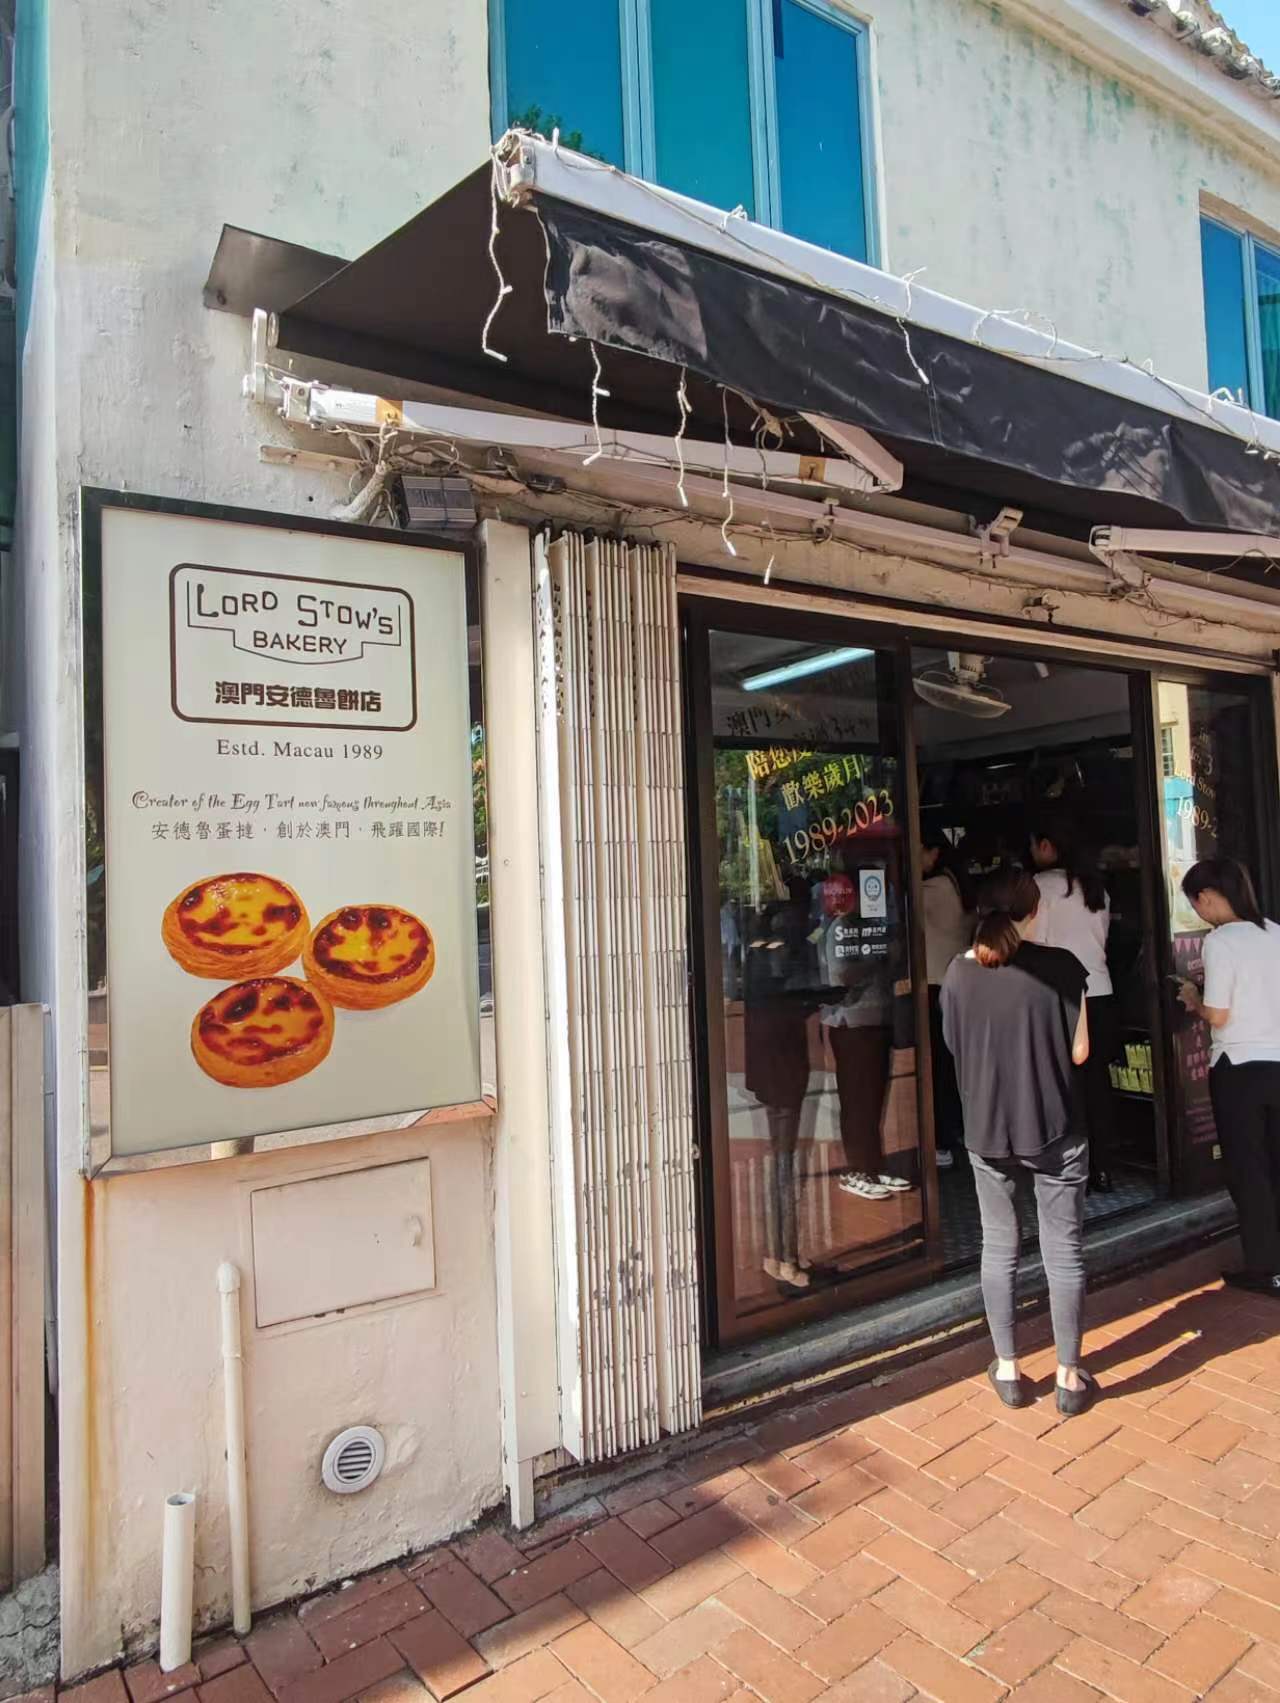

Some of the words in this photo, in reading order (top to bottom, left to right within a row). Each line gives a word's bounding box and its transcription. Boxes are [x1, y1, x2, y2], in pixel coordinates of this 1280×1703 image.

[253, 631, 347, 654] BAKERY
[215, 681, 381, 712] 澳門安德魯餅店
[217, 739, 265, 756] Estd.
[274, 742, 334, 758] Macau
[343, 744, 383, 759] 1989
[132, 791, 188, 809] Creator
[191, 792, 205, 811] of
[208, 794, 225, 808] the
[230, 793, 260, 813] Egg
[264, 793, 294, 809] Tart
[363, 796, 418, 813] throughout
[782, 788, 894, 865] 1989-2023
